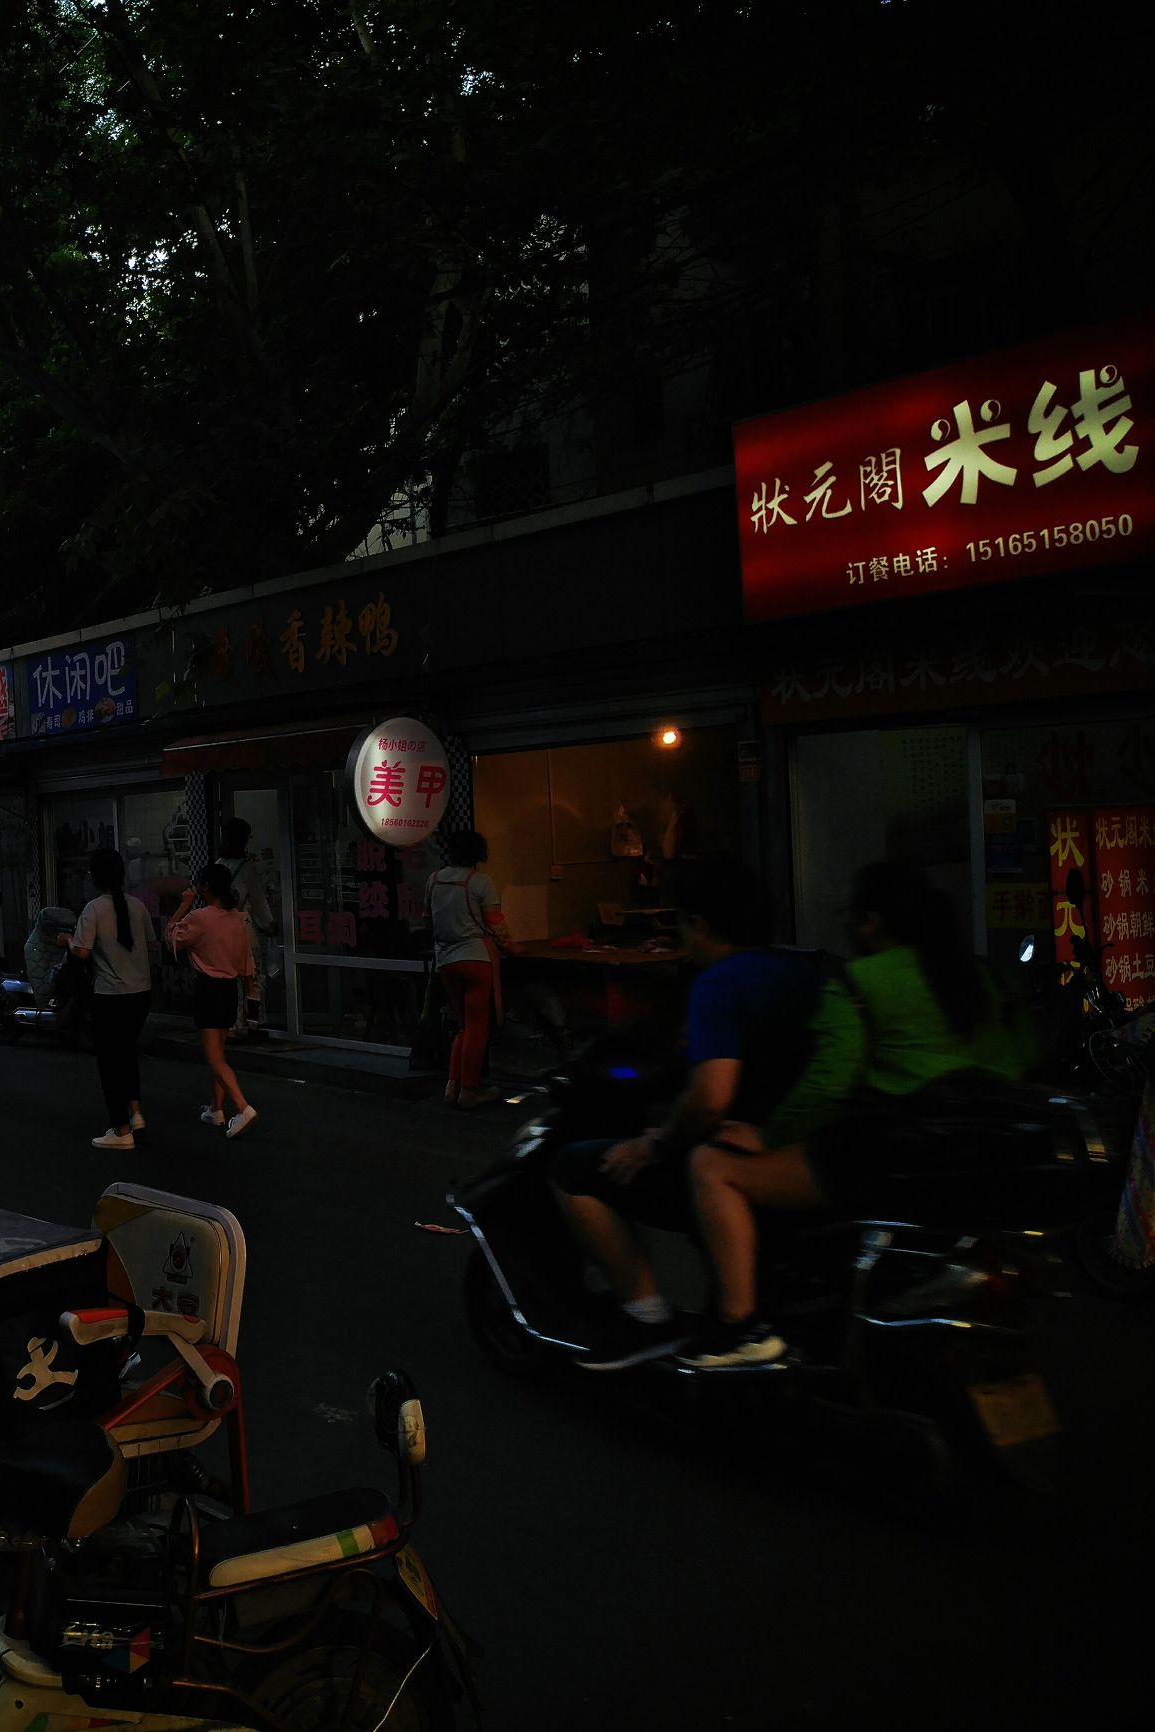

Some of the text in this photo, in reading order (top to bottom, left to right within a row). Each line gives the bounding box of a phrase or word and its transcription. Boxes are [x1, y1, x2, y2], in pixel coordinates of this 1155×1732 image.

[921, 364, 1140, 508] 米线
[966, 513, 1134, 563] 15165158050
[32, 640, 126, 709] 休闲吧
[366, 759, 447, 809] 美甲
[1095, 815, 1155, 850] 状元阁米
[1101, 868, 1155, 899] 砂锅米
